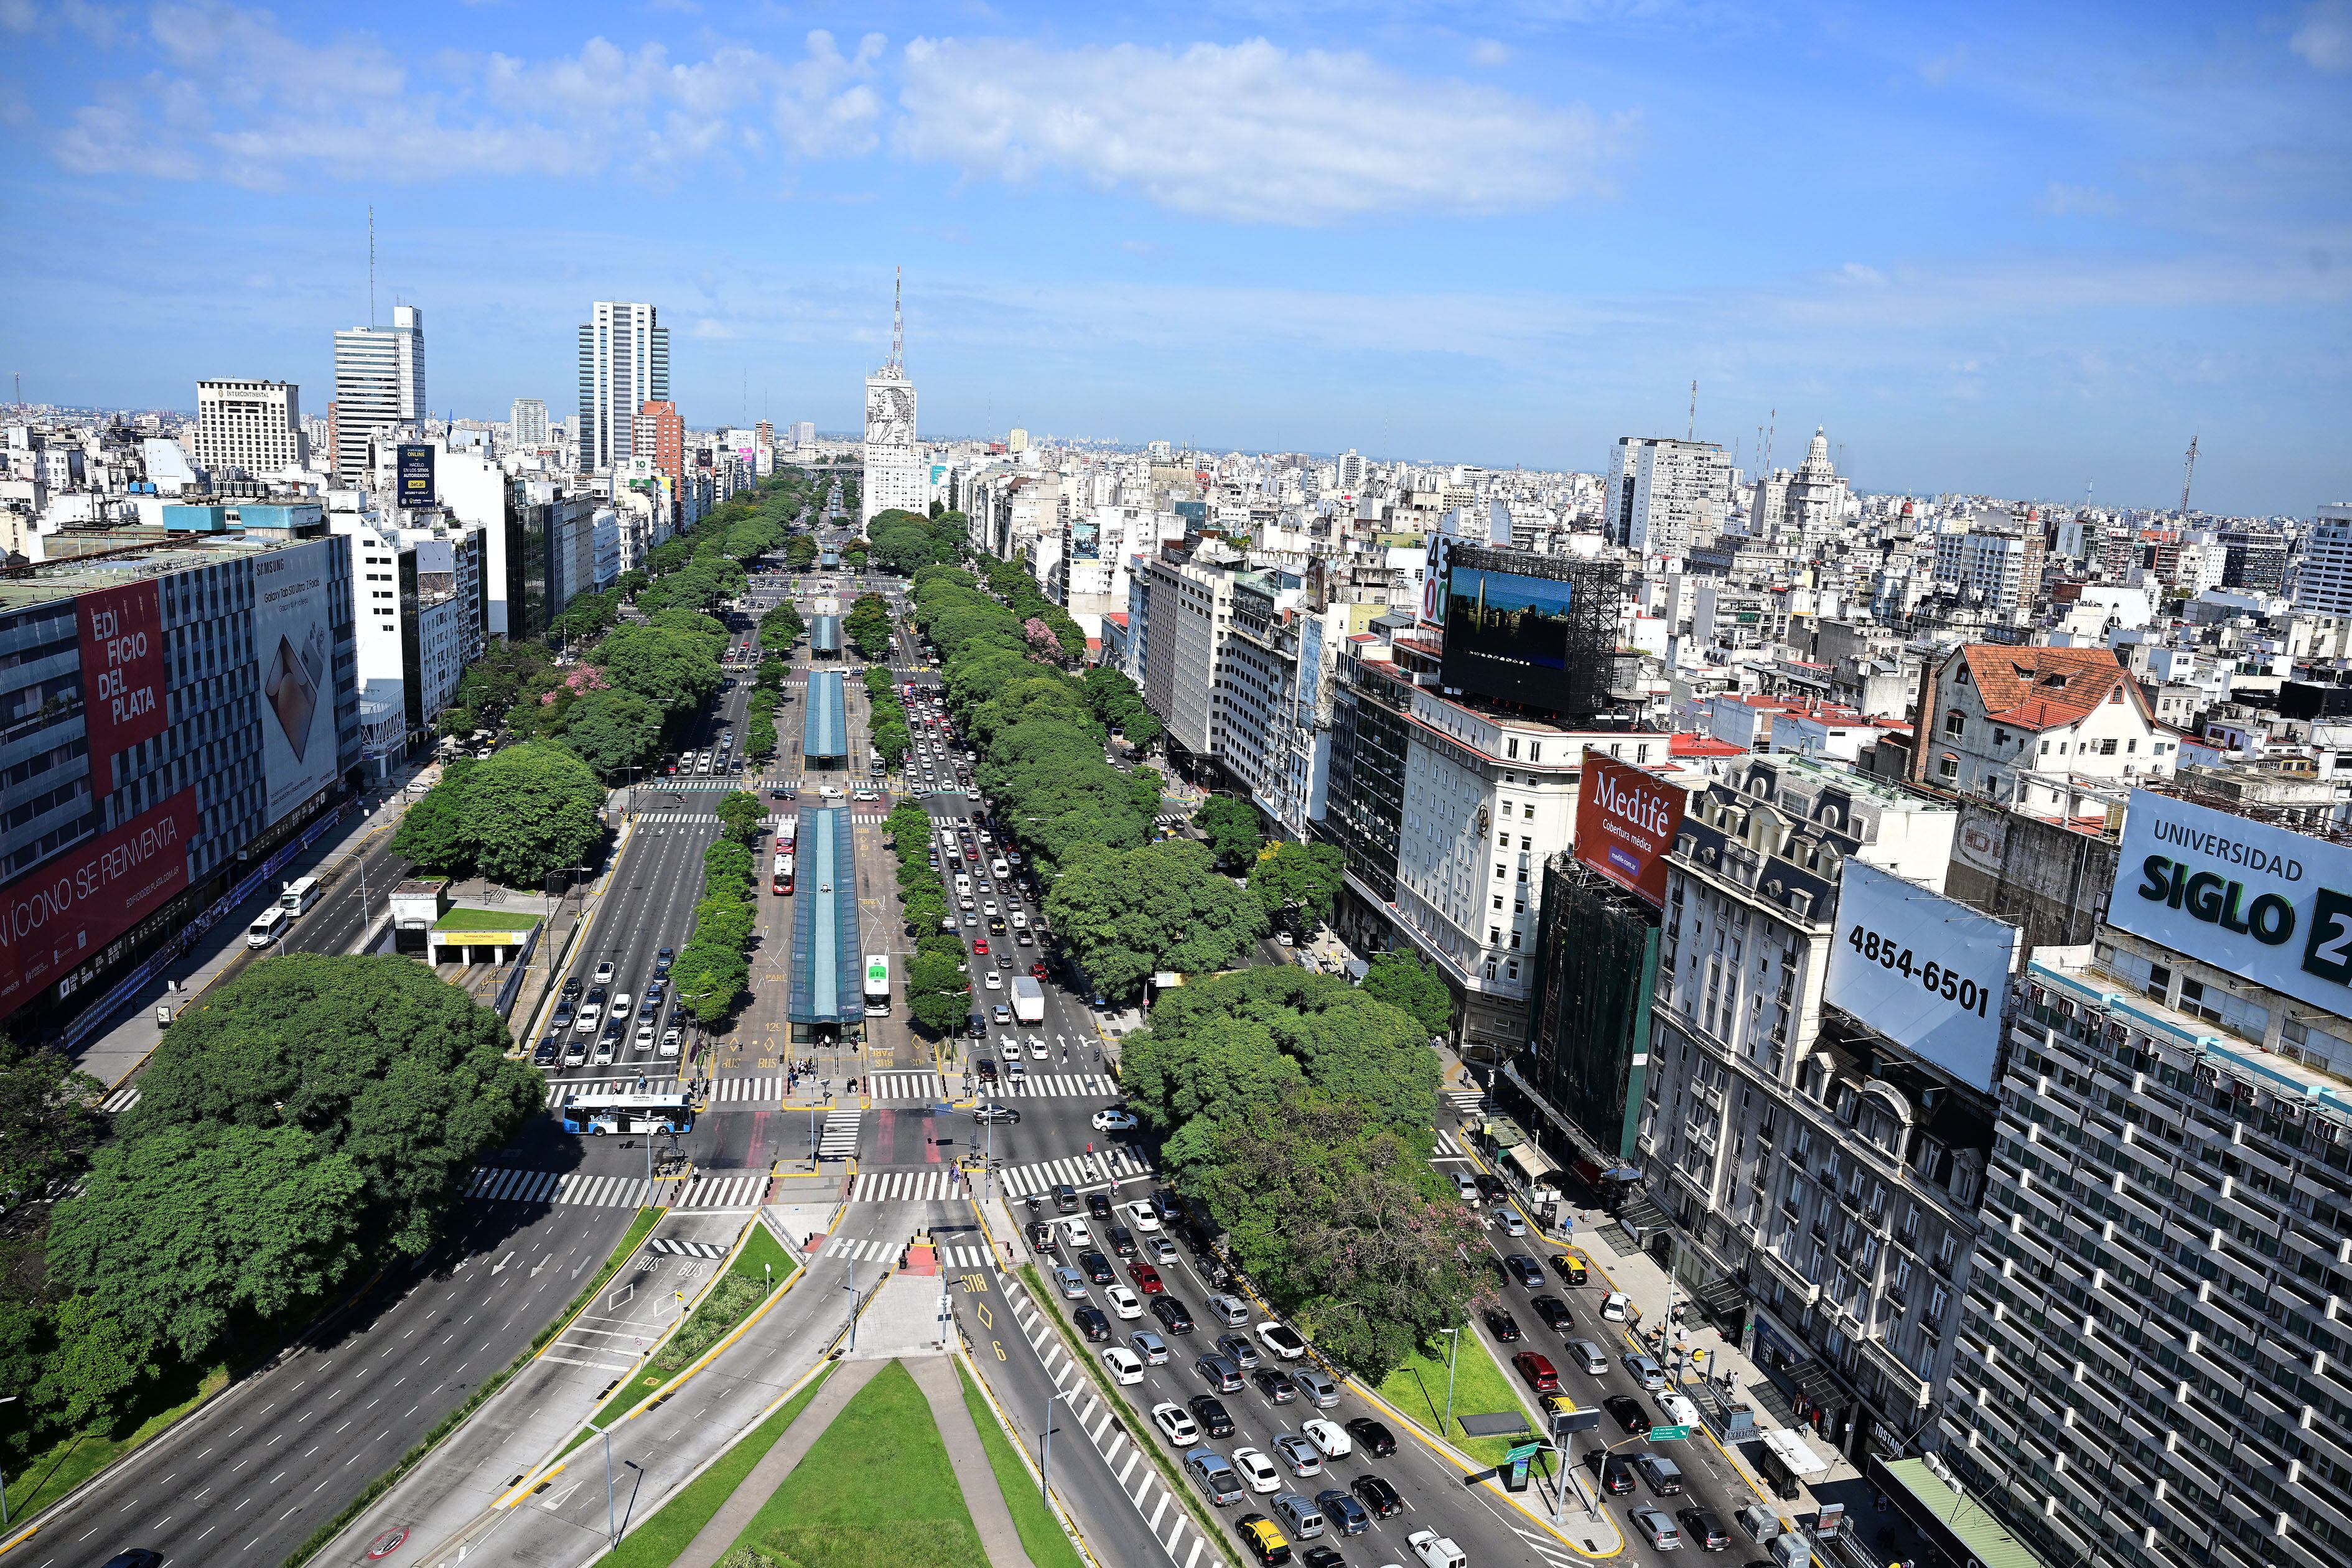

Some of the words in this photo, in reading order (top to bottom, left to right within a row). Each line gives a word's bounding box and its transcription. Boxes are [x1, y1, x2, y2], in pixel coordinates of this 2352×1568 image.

[257, 558, 284, 577] SAMSUNG
[264, 590, 280, 603] Galaxy
[93, 610, 119, 642] EDI
[107, 632, 147, 668] FICIO
[98, 668, 128, 701] DEL
[111, 686, 156, 726] PLATA
[1594, 771, 1669, 837] Medifé
[1603, 818, 1630, 841] Cobertura
[1631, 836, 1651, 853] médica
[2154, 819, 2303, 882] UNIVERSIDAD
[11, 878, 72, 941] ÍCONO
[76, 861, 99, 900] SE
[101, 816, 177, 885] REINVENTA
[1612, 852, 1636, 870] medife.com.ar
[126, 866, 179, 908] EDIFICIODELPLATA.COM.AR
[2138, 854, 2296, 946] SIGLO
[70, 973, 78, 984] CASA
[1849, 925, 1989, 1019] 4854-6501
[766, 1022, 782, 1032] 129
[2028, 982, 2163, 1062] HOTEL
[757, 1058, 778, 1068] BUS
[875, 1058, 894, 1068] BUS
[634, 1255, 665, 1272] BUS
[677, 1261, 708, 1278] BUS
[960, 1273, 988, 1293] BUS
[1875, 1422, 1904, 1458] TOSTADO
